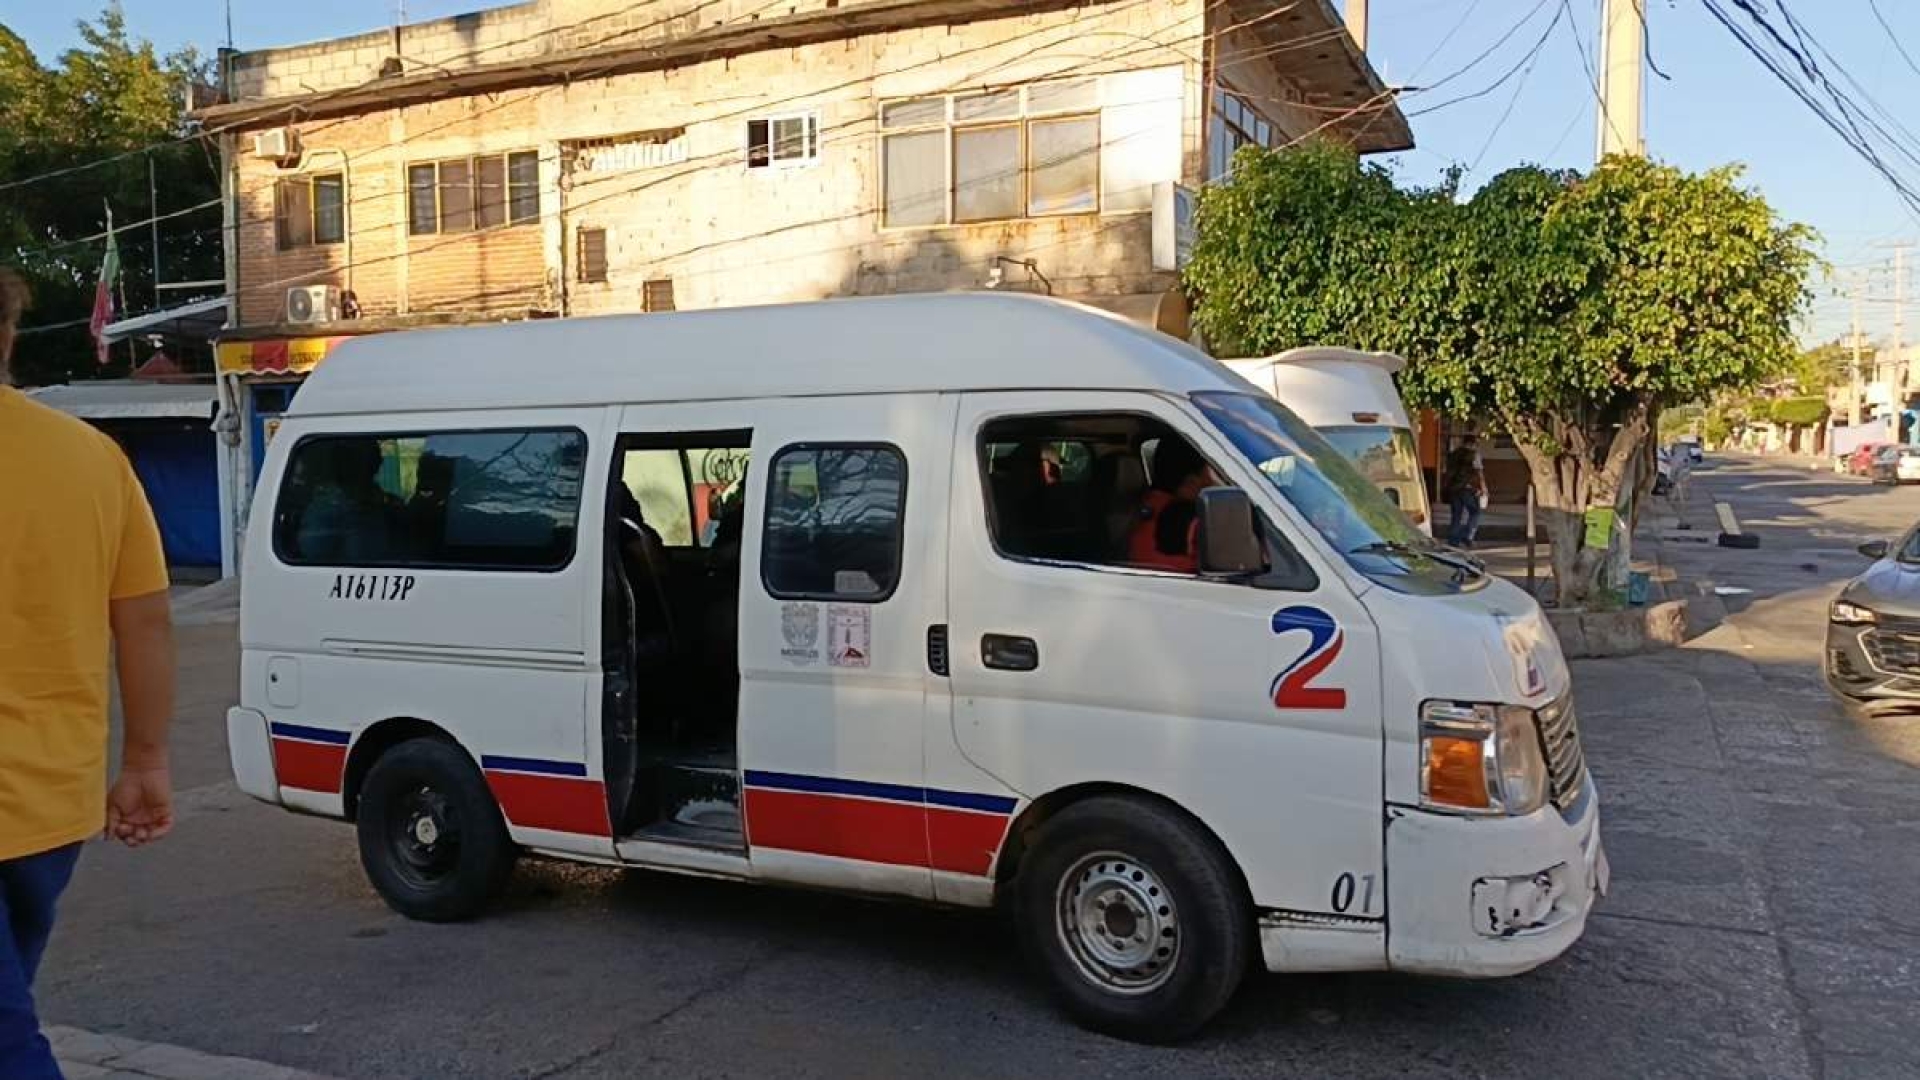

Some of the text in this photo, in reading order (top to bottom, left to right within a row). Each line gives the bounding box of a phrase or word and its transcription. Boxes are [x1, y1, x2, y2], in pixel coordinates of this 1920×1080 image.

[330, 574, 415, 600] A16113P
[1269, 605, 1347, 709] 2
[1331, 871, 1376, 914] 01
